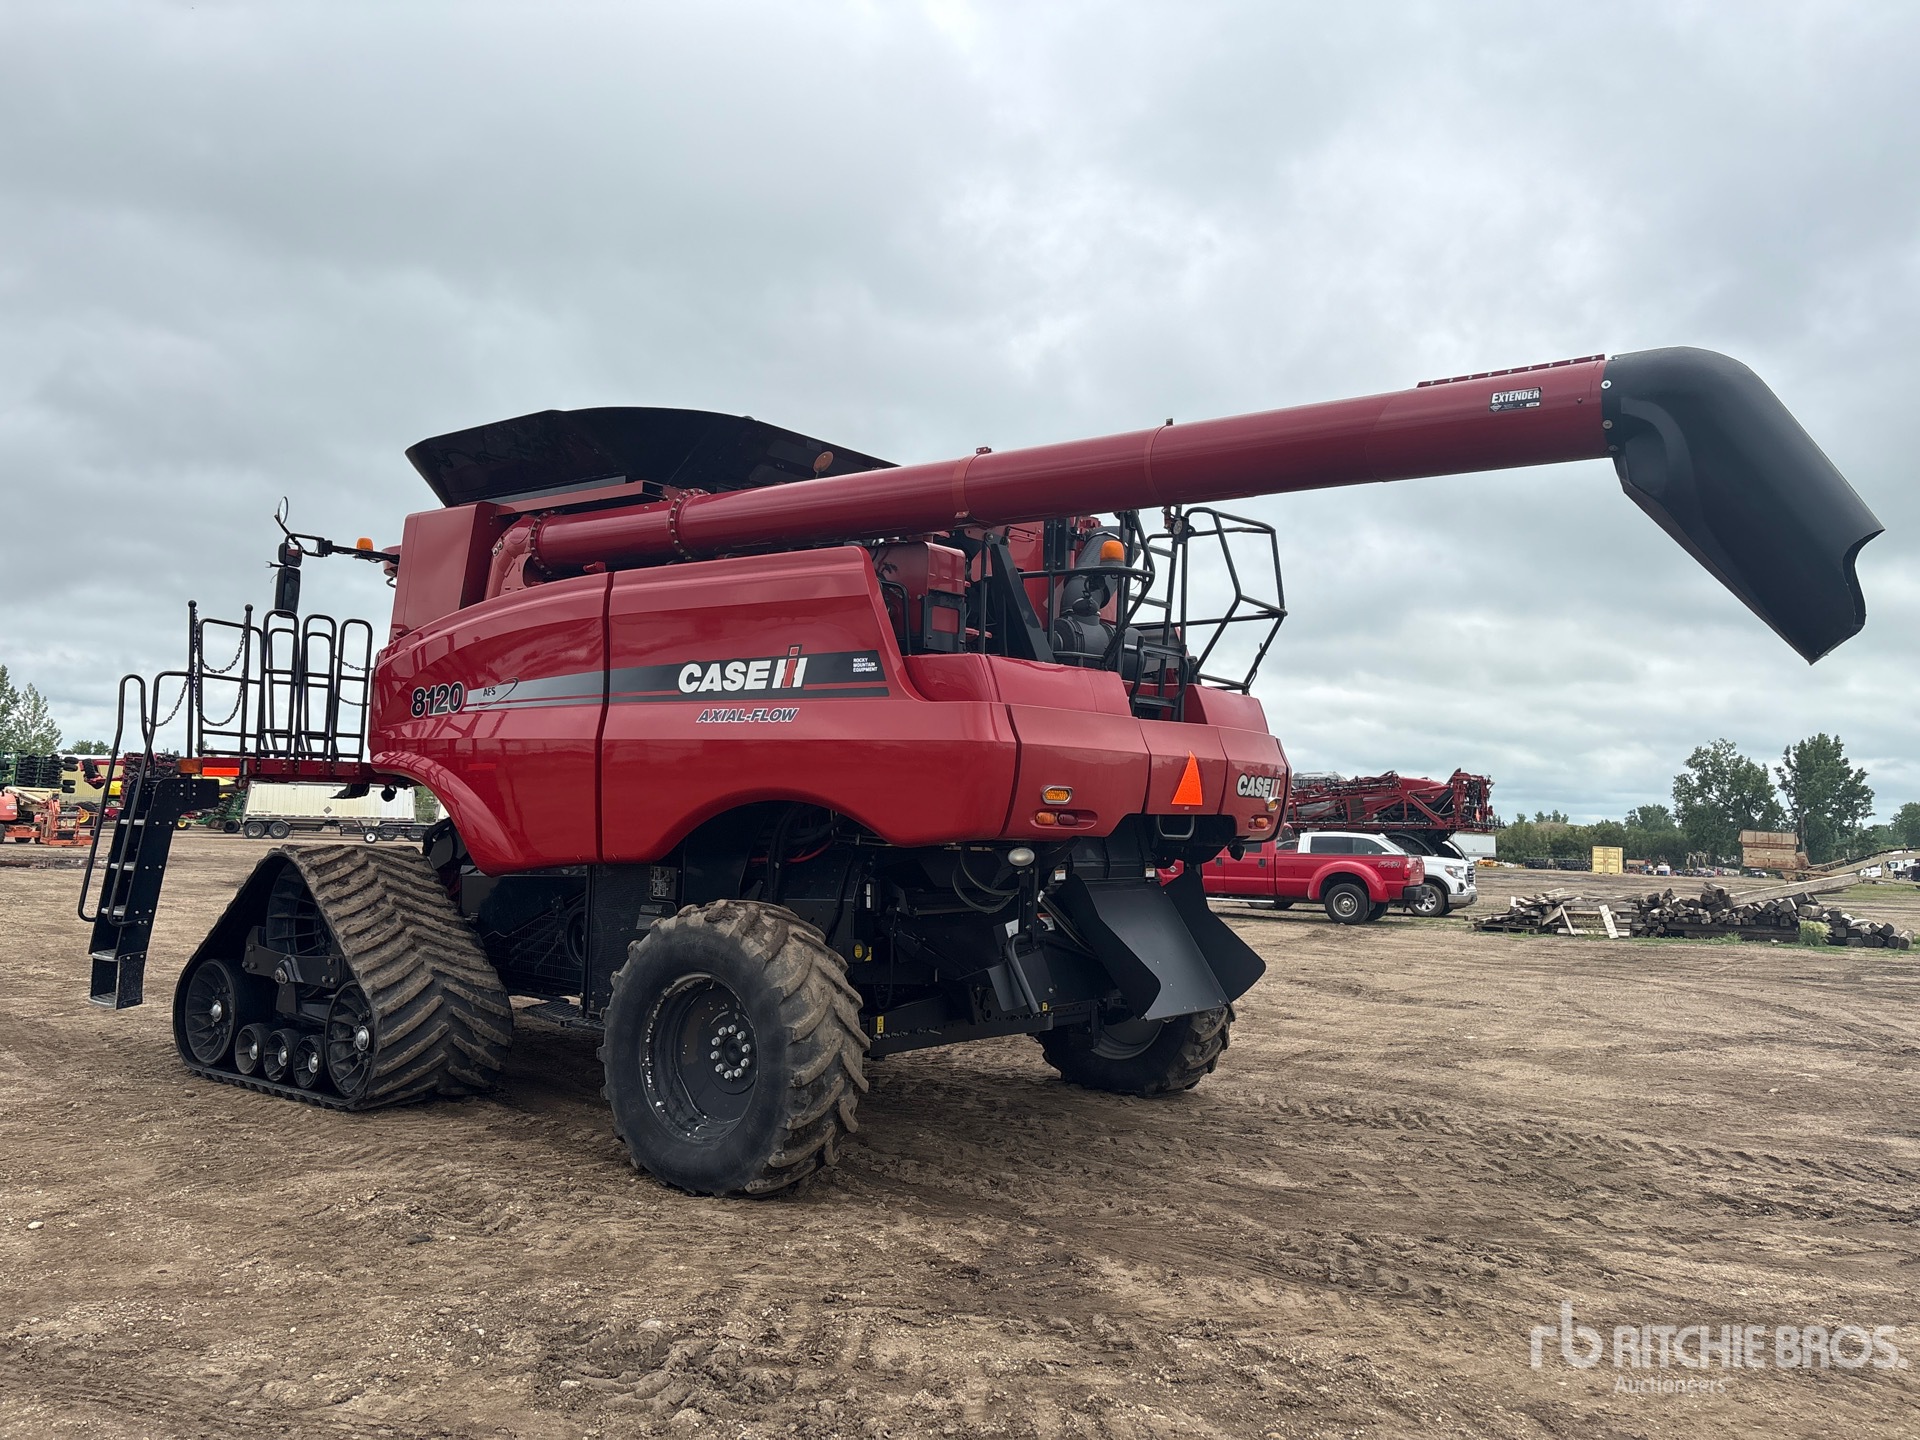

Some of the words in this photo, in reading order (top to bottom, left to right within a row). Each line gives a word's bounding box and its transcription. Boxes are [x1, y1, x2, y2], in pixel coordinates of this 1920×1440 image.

[1492, 390, 1540, 403] EXTENDER
[483, 687, 496, 697] AFS
[411, 681, 464, 718] 8120
[696, 708, 799, 723] AXIAL-FLOW
